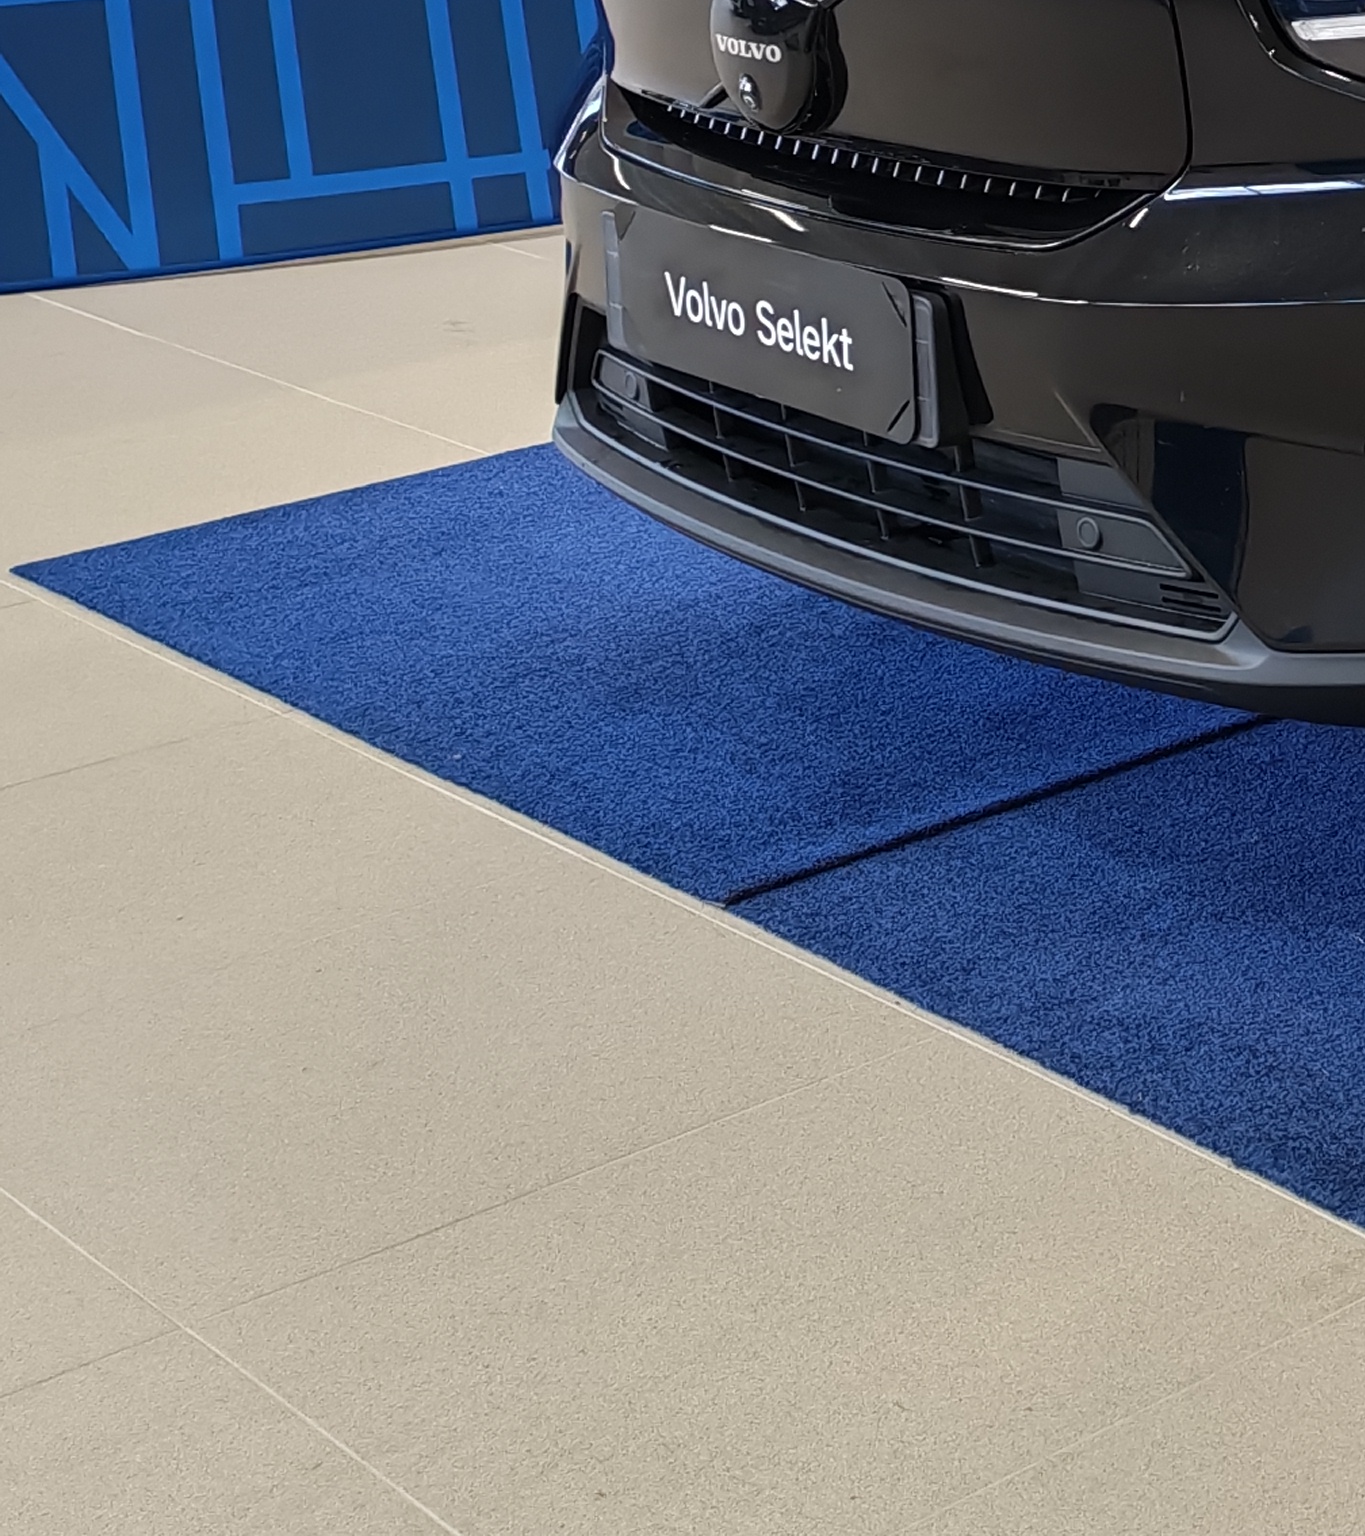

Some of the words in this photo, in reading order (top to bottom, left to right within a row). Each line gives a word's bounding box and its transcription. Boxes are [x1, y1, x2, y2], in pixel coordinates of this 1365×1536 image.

[715, 33, 782, 64] VOLVO
[663, 271, 746, 337] Volvo
[755, 299, 854, 372] Selekt
